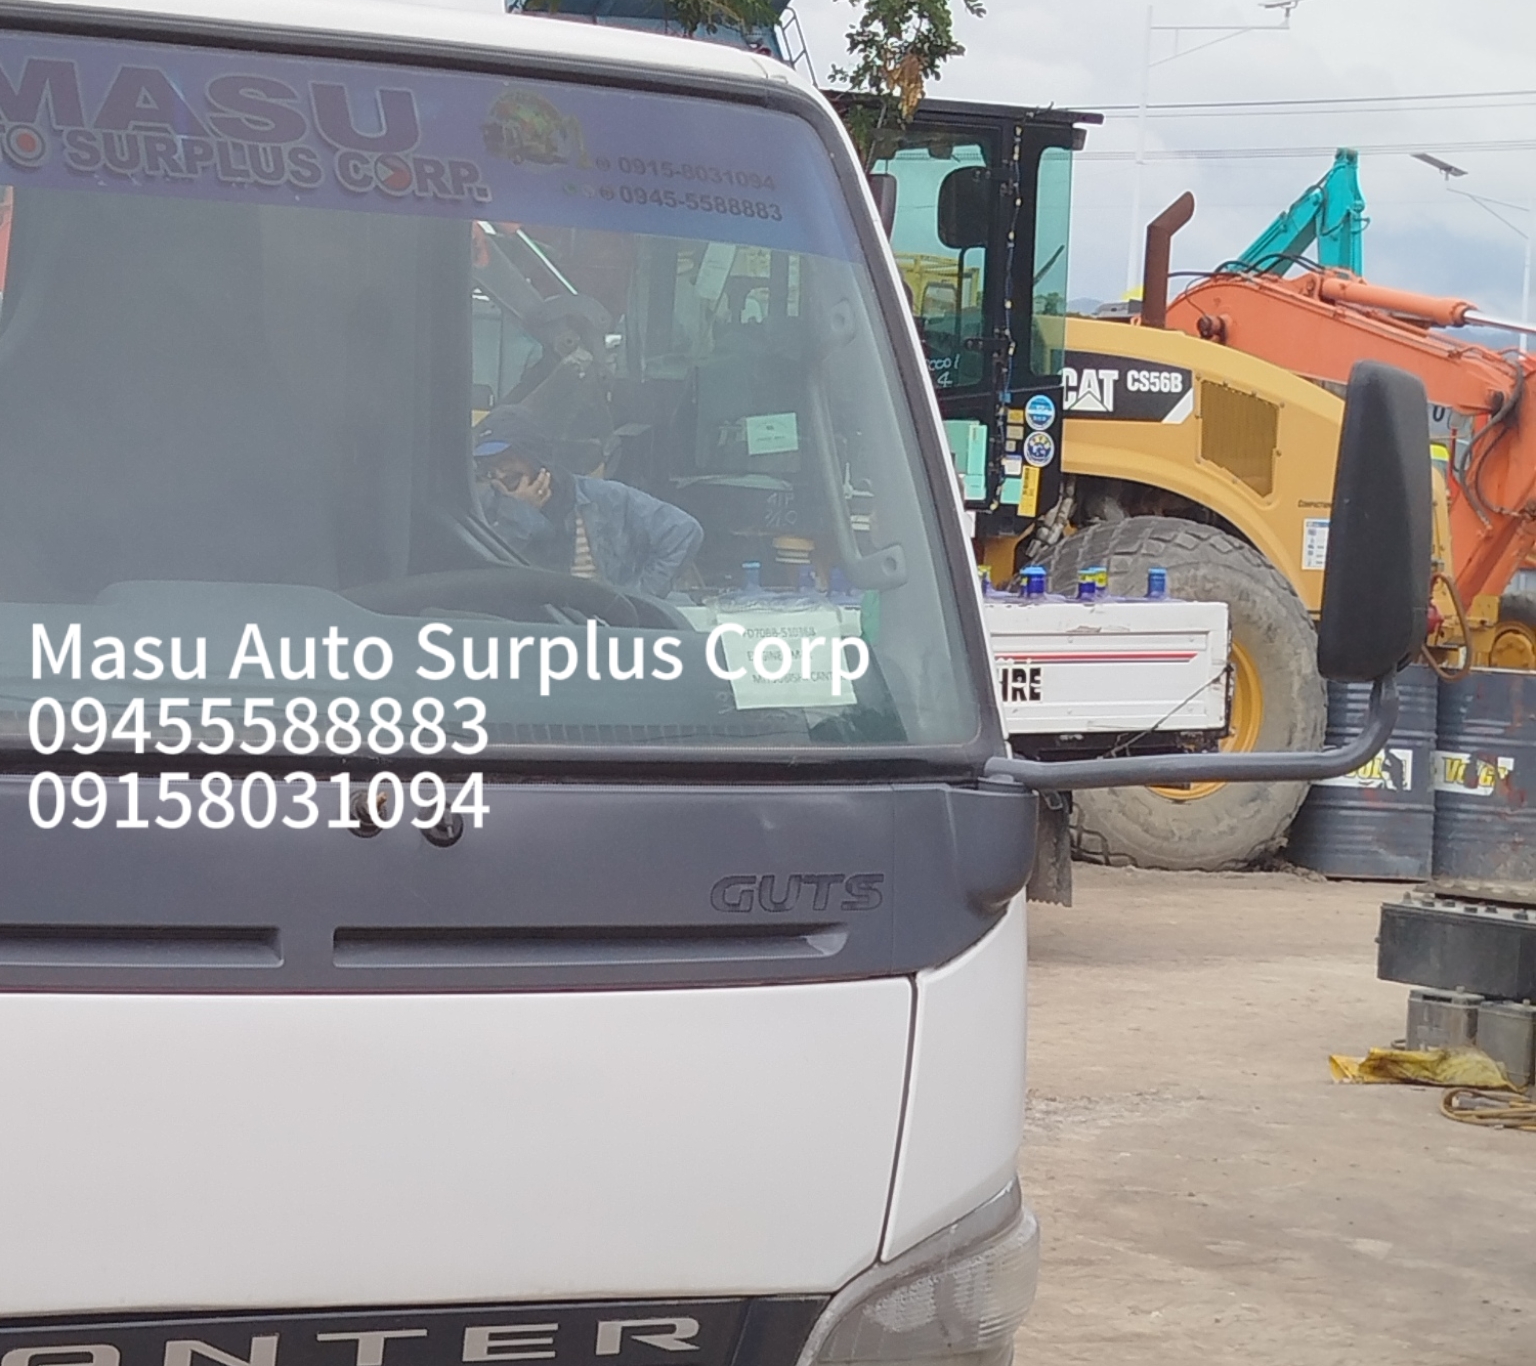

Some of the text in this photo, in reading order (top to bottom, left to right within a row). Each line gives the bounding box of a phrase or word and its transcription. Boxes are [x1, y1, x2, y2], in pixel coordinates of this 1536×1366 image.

[66, 127, 324, 189] SURPLUS
[335, 150, 492, 203] CORP.
[619, 185, 784, 221] 0945-5588883
[1057, 366, 1183, 412] CAT CS56B
[710, 873, 885, 913] GUTS
